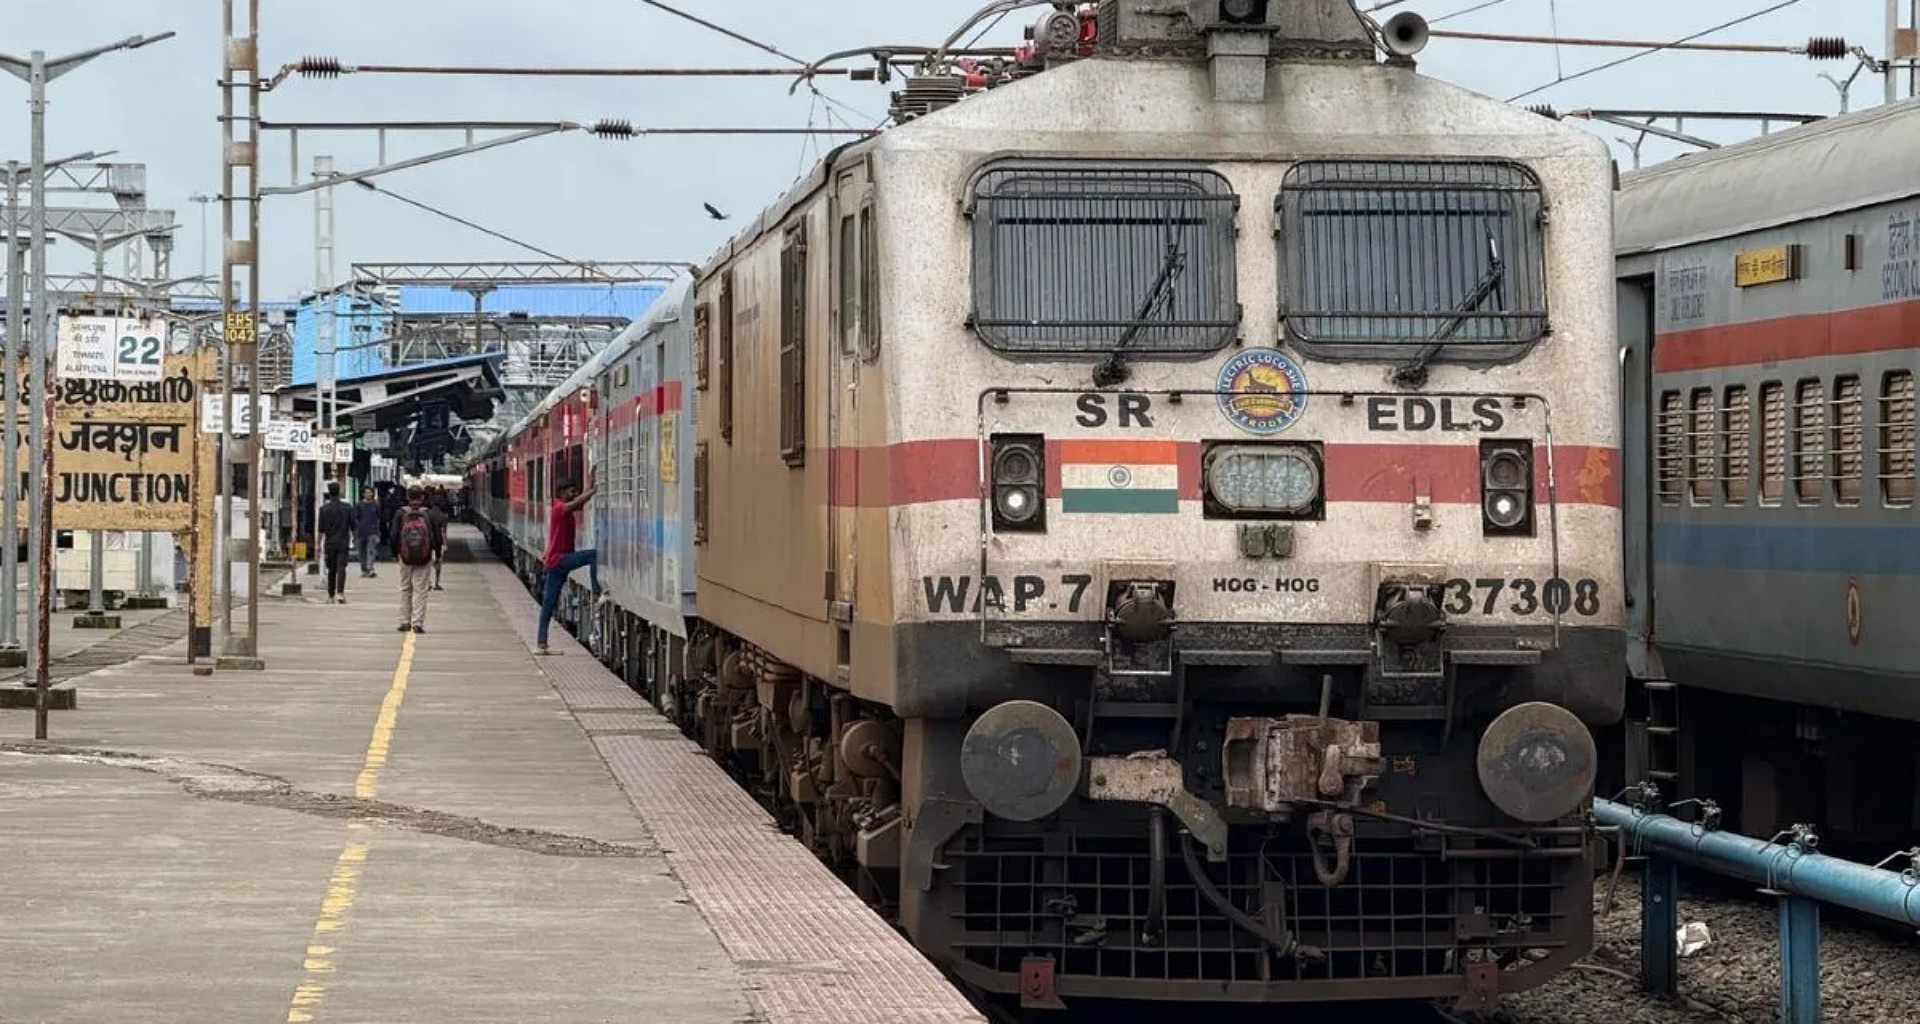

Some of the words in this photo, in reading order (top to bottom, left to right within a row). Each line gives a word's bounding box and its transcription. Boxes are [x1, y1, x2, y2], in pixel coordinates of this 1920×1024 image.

[226, 313, 254, 327] ERS
[225, 329, 256, 342] 1042
[118, 336, 160, 365] 22
[1258, 355, 1287, 369] LOCO
[1075, 393, 1153, 428] SR
[1367, 397, 1504, 431] EDLS
[58, 411, 187, 462] जंक्शन
[289, 430, 308, 443] 20
[320, 443, 332, 454] 19
[55, 472, 190, 503] JUNCTION
[1212, 578, 1256, 592] HOG
[1275, 578, 1319, 592] HOG
[1444, 578, 1600, 616] 37308
